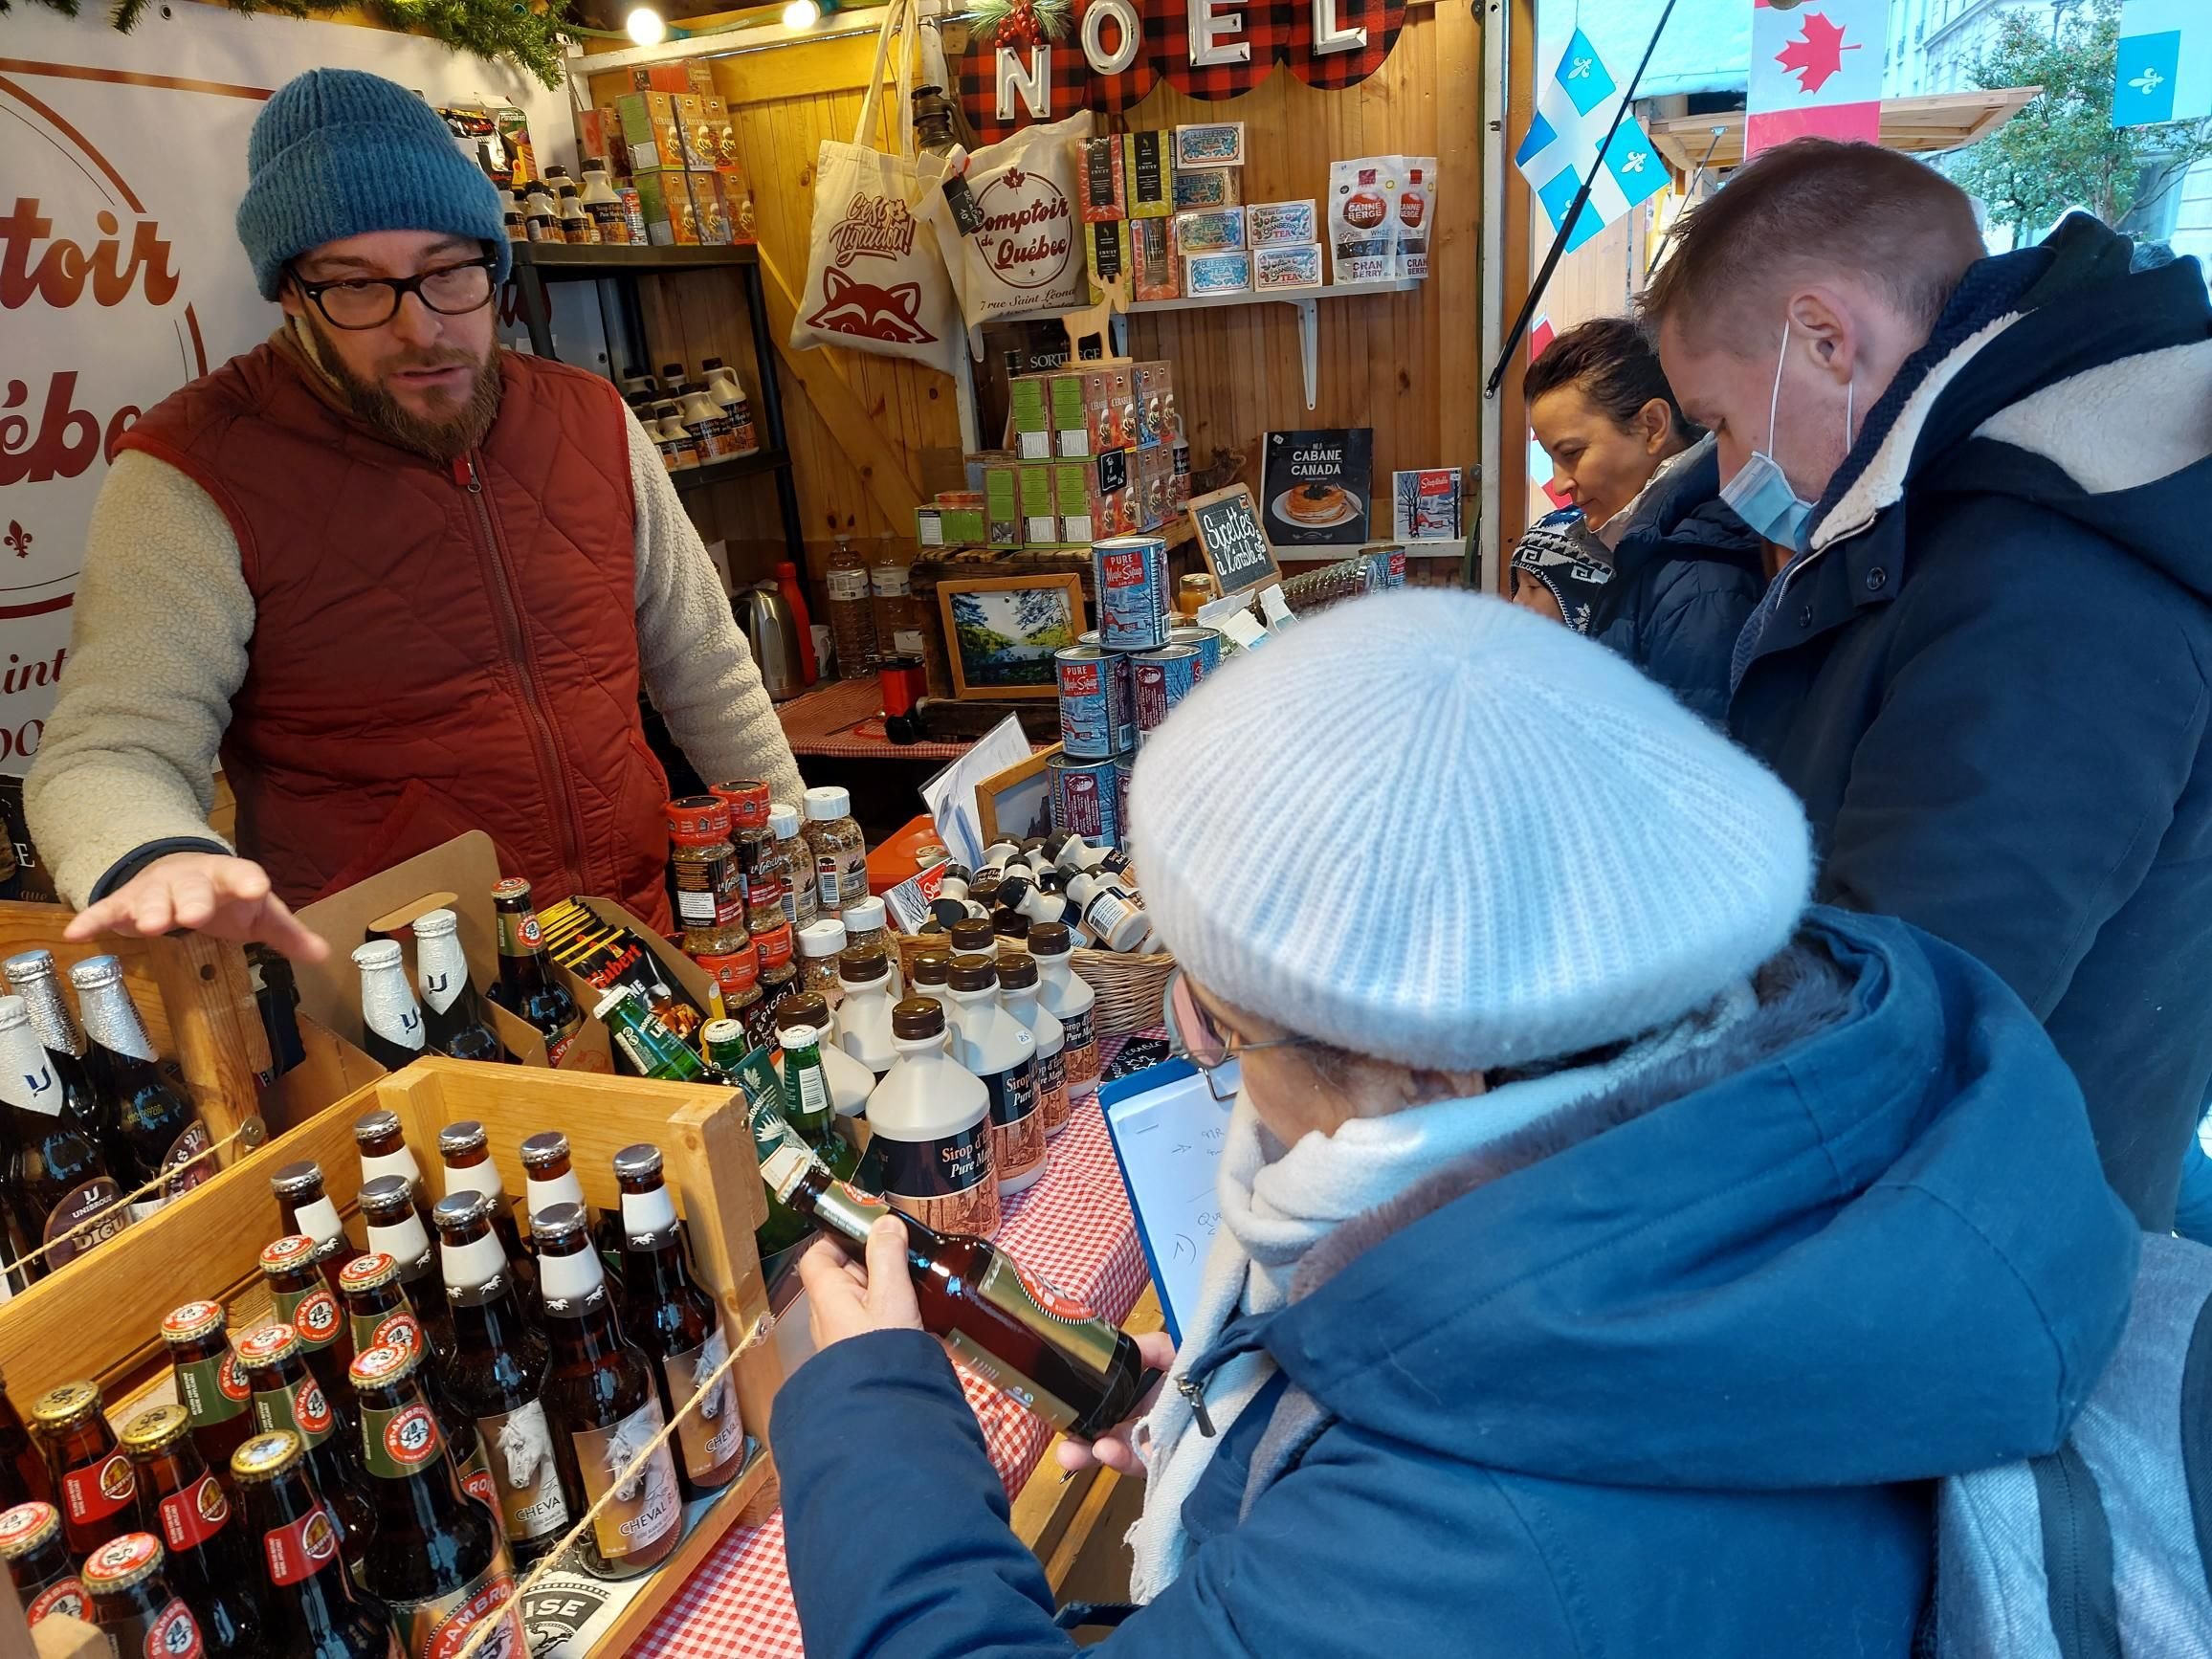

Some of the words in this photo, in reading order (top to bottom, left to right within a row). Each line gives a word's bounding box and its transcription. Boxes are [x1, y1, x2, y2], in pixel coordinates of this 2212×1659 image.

[1348, 202, 1382, 211] CANNE
[969, 197, 1069, 234] Comptoir
[1348, 210, 1382, 220] BERGE
[981, 234, 994, 247] de
[994, 234, 1068, 270] Québec
[1353, 260, 1382, 271] CRAN
[1353, 270, 1382, 278] BERRY
[986, 300, 1006, 309] rue
[1009, 295, 1039, 307] Saint
[1293, 450, 1342, 461] CABANE
[1292, 464, 1341, 476] CANADA
[1204, 507, 1255, 549] Sucettes
[1111, 554, 1133, 565] PURE
[1215, 553, 1227, 575] à
[1067, 666, 1087, 675] PURE
[1067, 1032, 1082, 1042] Pure
[1006, 1073, 1030, 1093] Sirop
[1013, 1089, 1032, 1107] Pure
[941, 1143, 973, 1162] Sirop
[950, 1161, 975, 1178] Pure
[71, 1195, 113, 1219] UNIBROUE
[619, 1501, 668, 1537] CHEVAL
